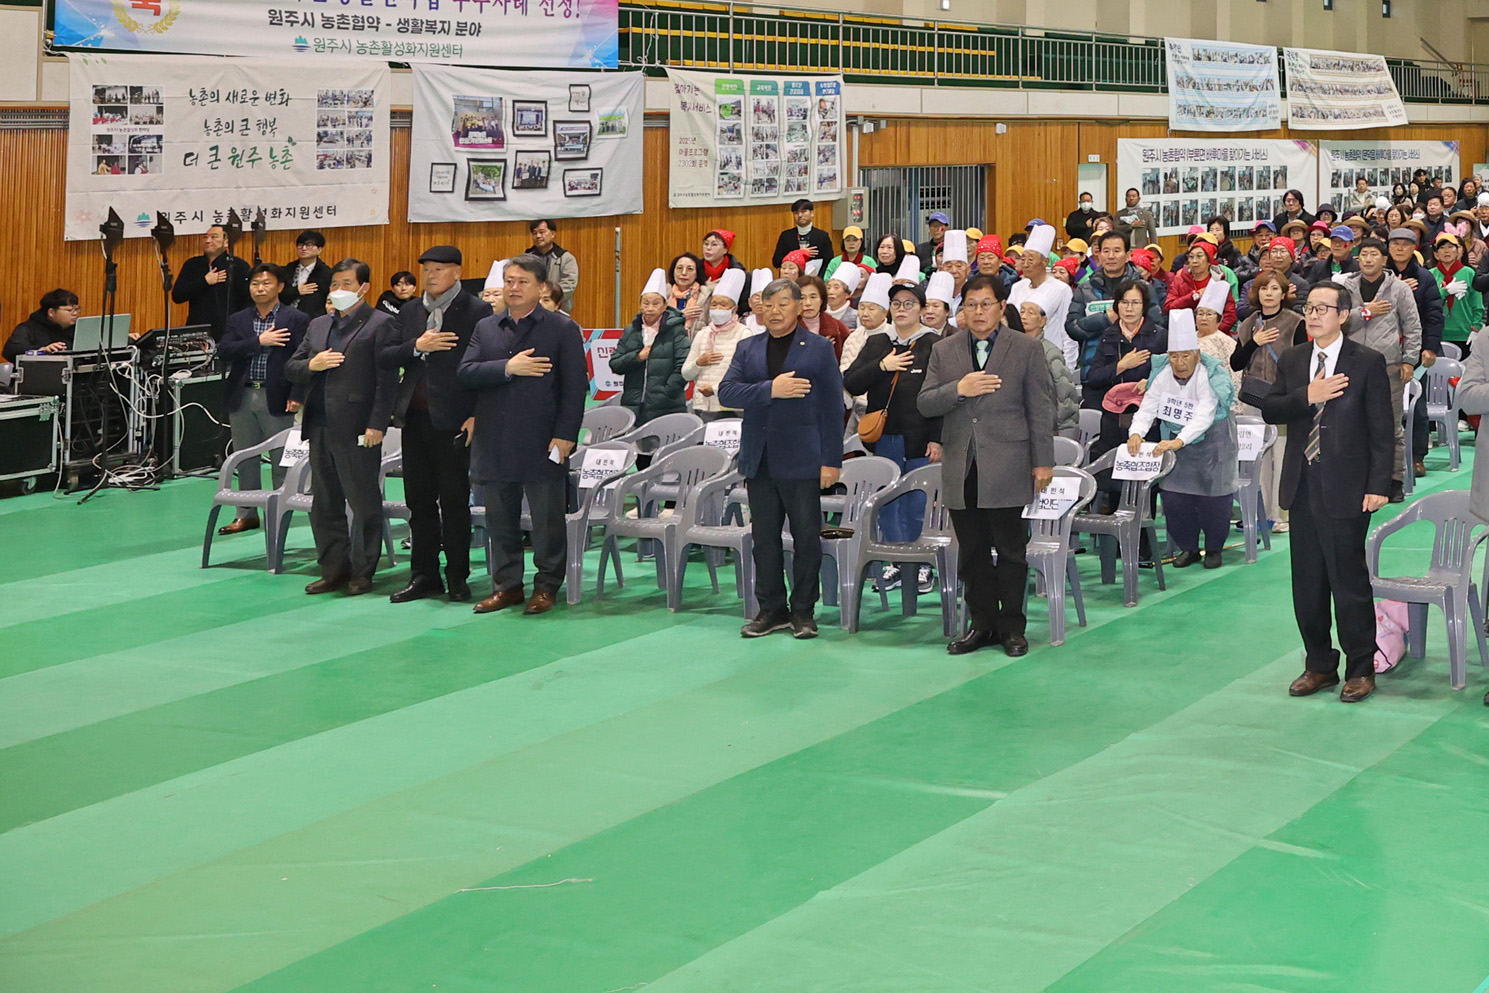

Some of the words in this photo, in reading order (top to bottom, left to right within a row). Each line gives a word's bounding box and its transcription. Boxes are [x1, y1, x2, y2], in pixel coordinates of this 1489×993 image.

[268, 8, 316, 29] 원주시
[320, 12, 381, 33] 농촌협약
[396, 17, 451, 36] 생활복지
[455, 21, 482, 38] 분야
[313, 37, 352, 54] 원주시
[356, 38, 464, 58] 농촌활성화지원센터
[189, 87, 220, 107] 농촌의
[225, 88, 260, 106] 새로운
[265, 88, 292, 106] 변화
[204, 118, 235, 137] 농촌의
[239, 118, 251, 136] 큰
[256, 117, 277, 138] 행복
[183, 152, 199, 167] 더
[207, 145, 222, 170] 큰
[228, 146, 263, 169] 원주
[269, 145, 294, 170] 농촌
[1142, 148, 1161, 162] 원주시
[1162, 148, 1186, 162] 농촌협약
[212, 205, 337, 224] 농활화지원센터
[1116, 460, 1160, 472] 농축협조합장
